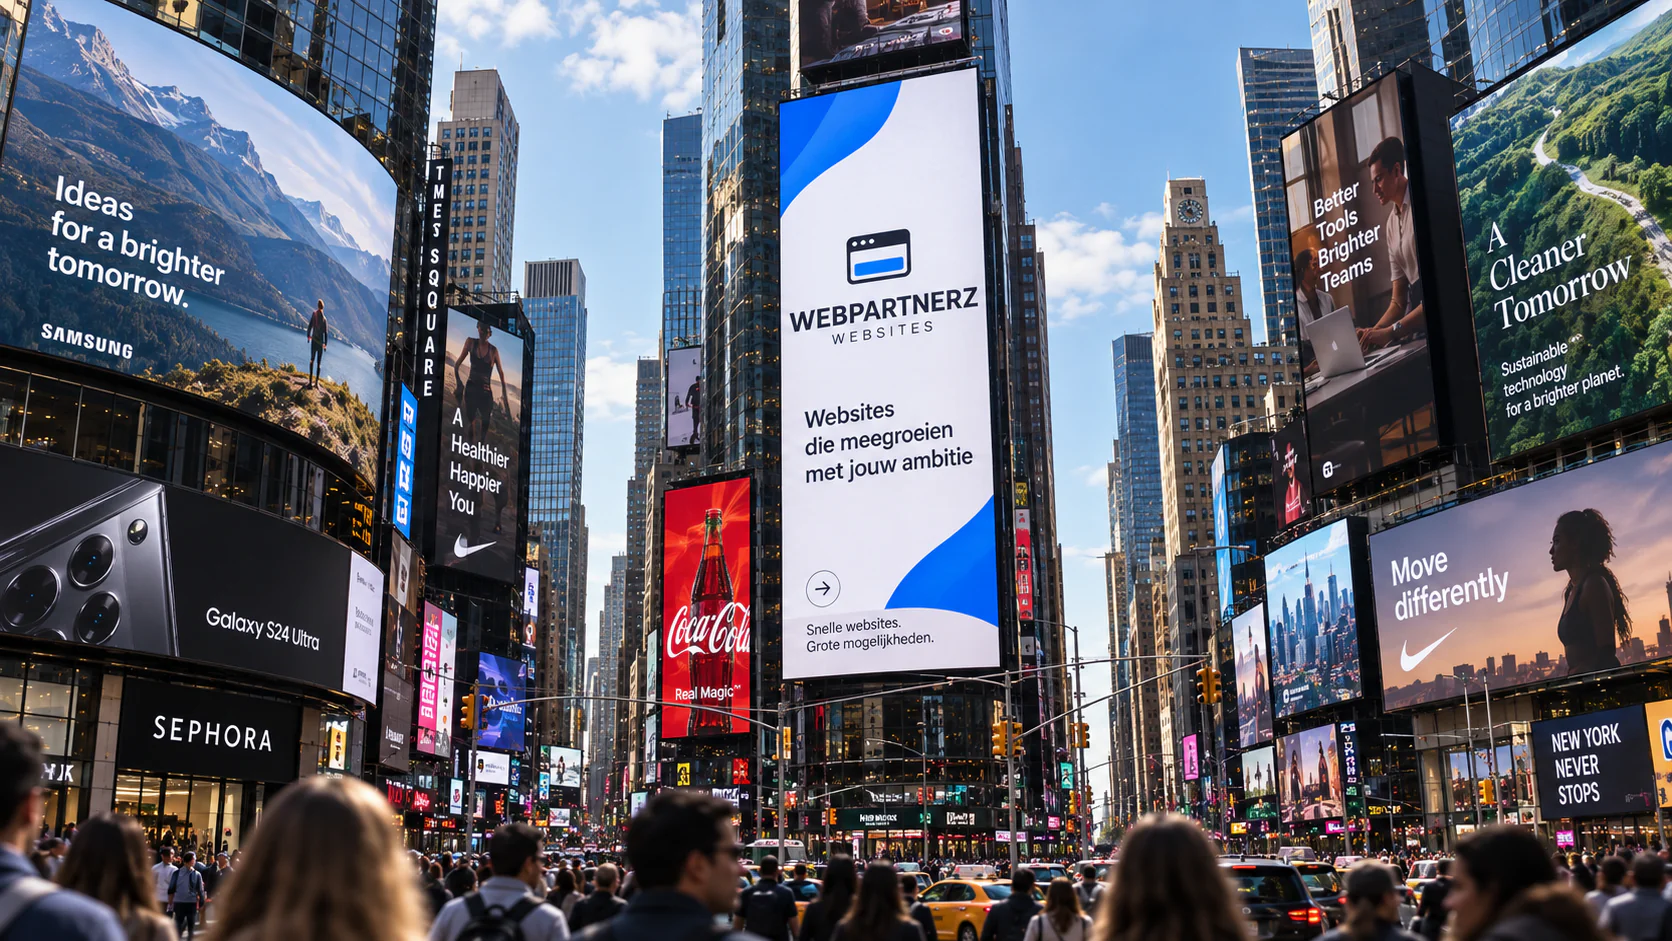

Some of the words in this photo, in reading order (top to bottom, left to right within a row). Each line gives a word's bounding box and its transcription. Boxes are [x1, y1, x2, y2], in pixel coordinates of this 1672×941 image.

[55, 176, 134, 222] Ideas
[1313, 180, 1360, 219] Better
[1315, 211, 1359, 243] Tools
[1486, 221, 1508, 254] A
[51, 210, 94, 244] for
[98, 230, 116, 252] a
[120, 229, 226, 286] brighter
[1317, 225, 1381, 269] Brighter
[1489, 232, 1587, 291] Cleaner
[47, 246, 190, 308] tomorrow.
[1319, 254, 1374, 293] Teams
[789, 286, 979, 333] WEBPARTNERZ
[1493, 255, 1632, 331] Tomorrow
[41, 323, 134, 360] SAMSUNG
[831, 320, 934, 345] WEBSITES
[1501, 341, 1569, 377] Sustainable
[1503, 364, 1568, 397] technology
[1505, 403, 1522, 418] for
[1524, 399, 1532, 412] a
[1533, 381, 1580, 408] brighter
[1581, 364, 1625, 394] planet.
[452, 407, 464, 428] A
[804, 402, 895, 429] Websites
[451, 433, 510, 469] Healthier
[804, 436, 835, 456] die
[840, 422, 954, 452] meegroeien
[450, 461, 502, 494] Happier
[805, 463, 844, 484] met
[848, 456, 898, 483] jouw
[902, 446, 974, 471] ambitie
[448, 490, 475, 516] You
[1391, 551, 1449, 587] Move
[1394, 567, 1509, 621] differently
[206, 606, 264, 641] Galaxy
[266, 620, 291, 643] S24
[292, 629, 320, 652] Ultra
[806, 621, 843, 636] Snelle
[845, 617, 902, 633] websites.
[806, 638, 841, 653] Grote
[843, 632, 935, 651] mogelijkheden.
[675, 686, 698, 701] Real
[153, 714, 272, 753] SEPHORA
[1551, 728, 1581, 754] NEW
[1582, 722, 1622, 748] YORK
[1554, 754, 1601, 779] NEVER
[1558, 781, 1601, 806] STOPS
